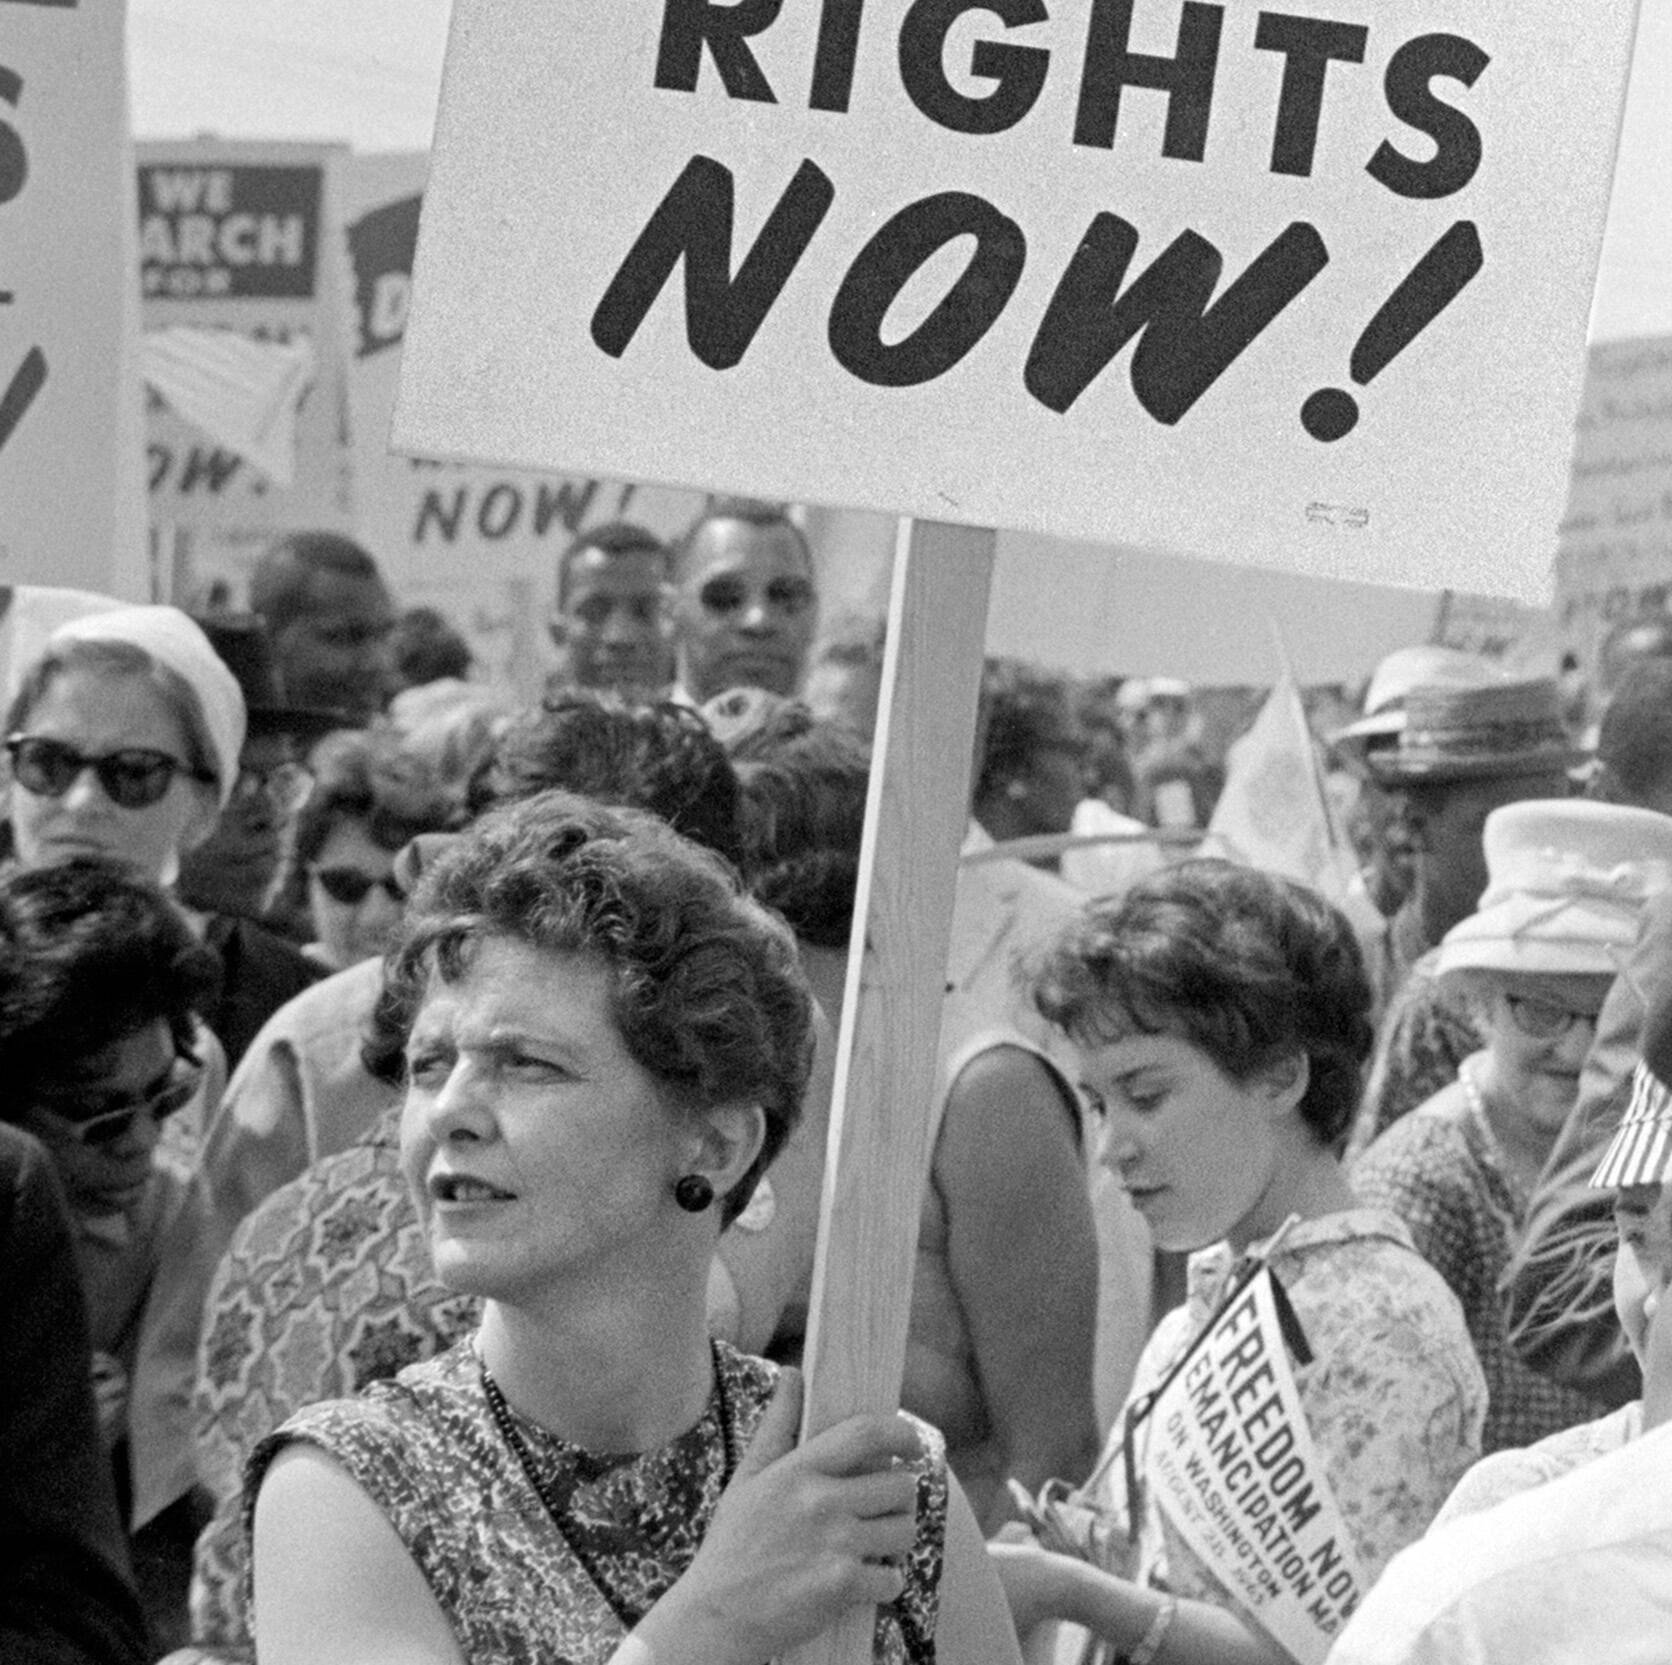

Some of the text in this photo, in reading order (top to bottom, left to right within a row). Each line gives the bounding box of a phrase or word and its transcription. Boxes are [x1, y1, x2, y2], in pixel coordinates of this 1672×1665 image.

[150, 170, 236, 213] WE
[590, 155, 1483, 442] NOW!
[1184, 1351, 1316, 1599] EMANCIPATION
[1185, 1450, 1283, 1599] WASHINGTON
[1215, 1291, 1323, 1534] FREEDOM
